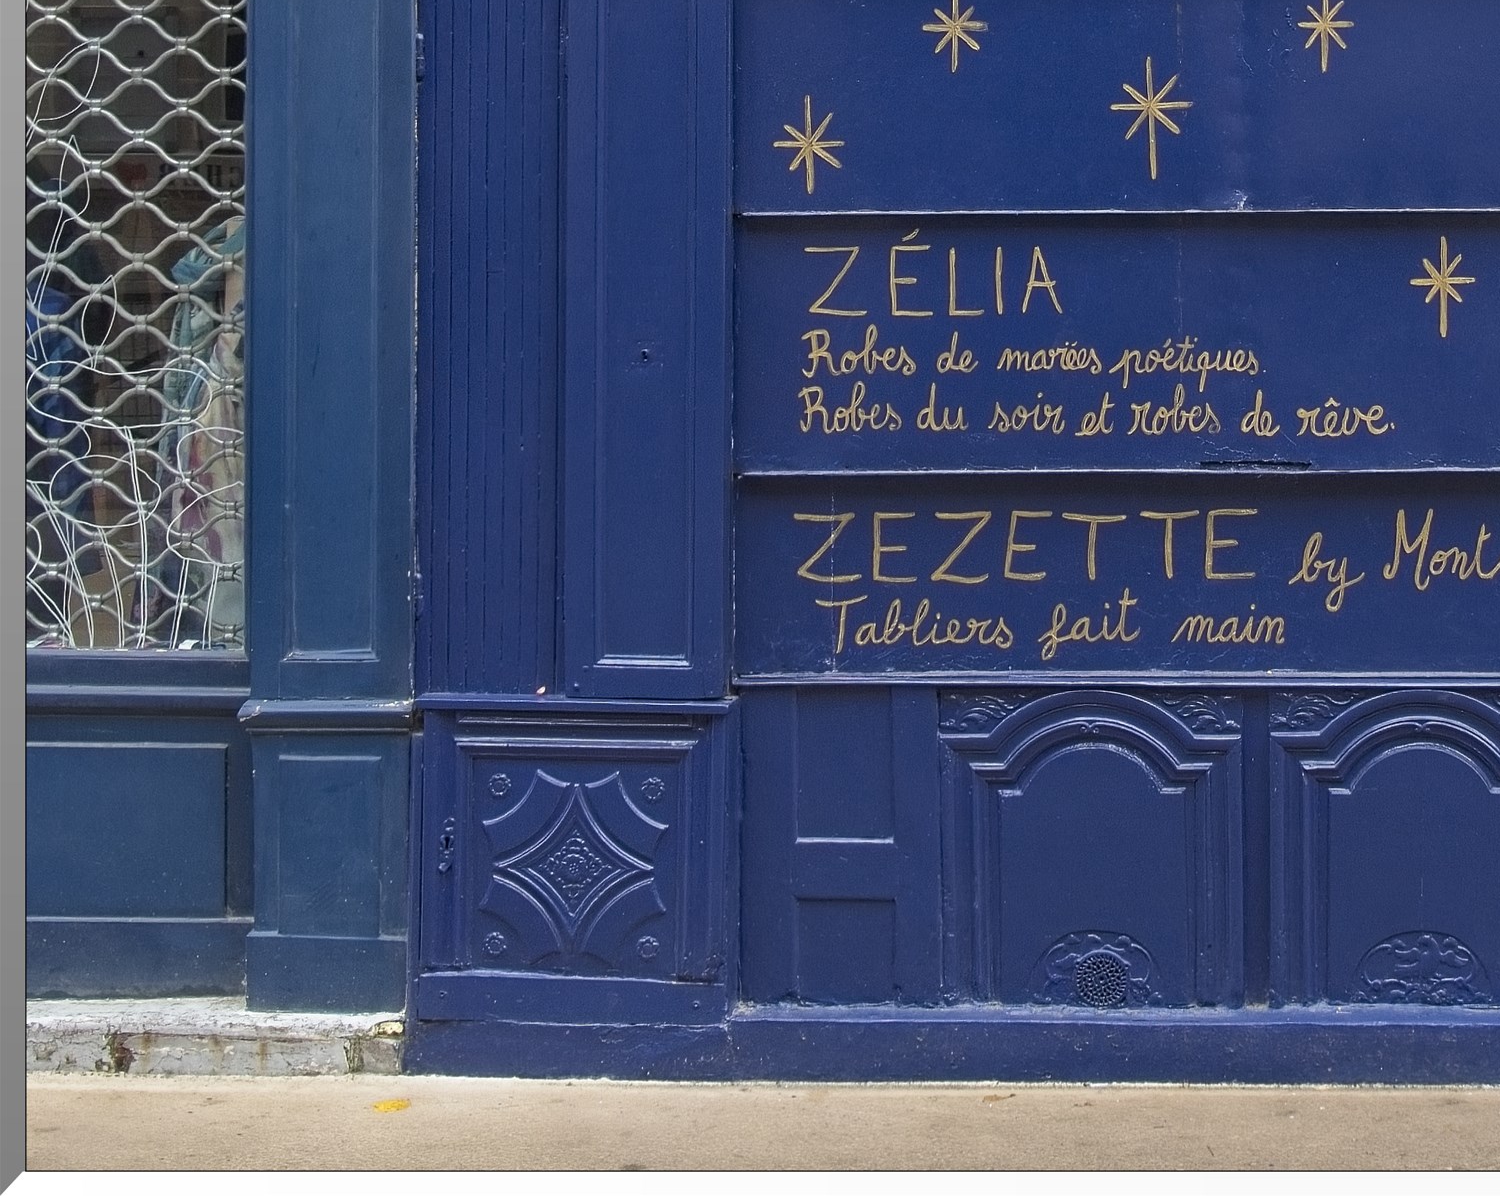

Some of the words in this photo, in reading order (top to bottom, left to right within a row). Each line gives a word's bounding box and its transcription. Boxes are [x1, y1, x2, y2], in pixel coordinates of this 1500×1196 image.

[804, 228, 1063, 317] ZÉLIA
[801, 324, 917, 378] Robes
[936, 331, 979, 373] de
[798, 380, 903, 434] Robes
[916, 382, 969, 431] du
[988, 392, 1066, 434] soir
[1074, 392, 1115, 436] et
[1127, 383, 1221, 435] robes
[1241, 389, 1280, 437] de
[793, 508, 1259, 584] ZEZETTE
[1288, 531, 1365, 612] by
[815, 594, 1014, 654] Tabliers
[1038, 587, 1141, 661] fait
[1171, 604, 1286, 645] main
